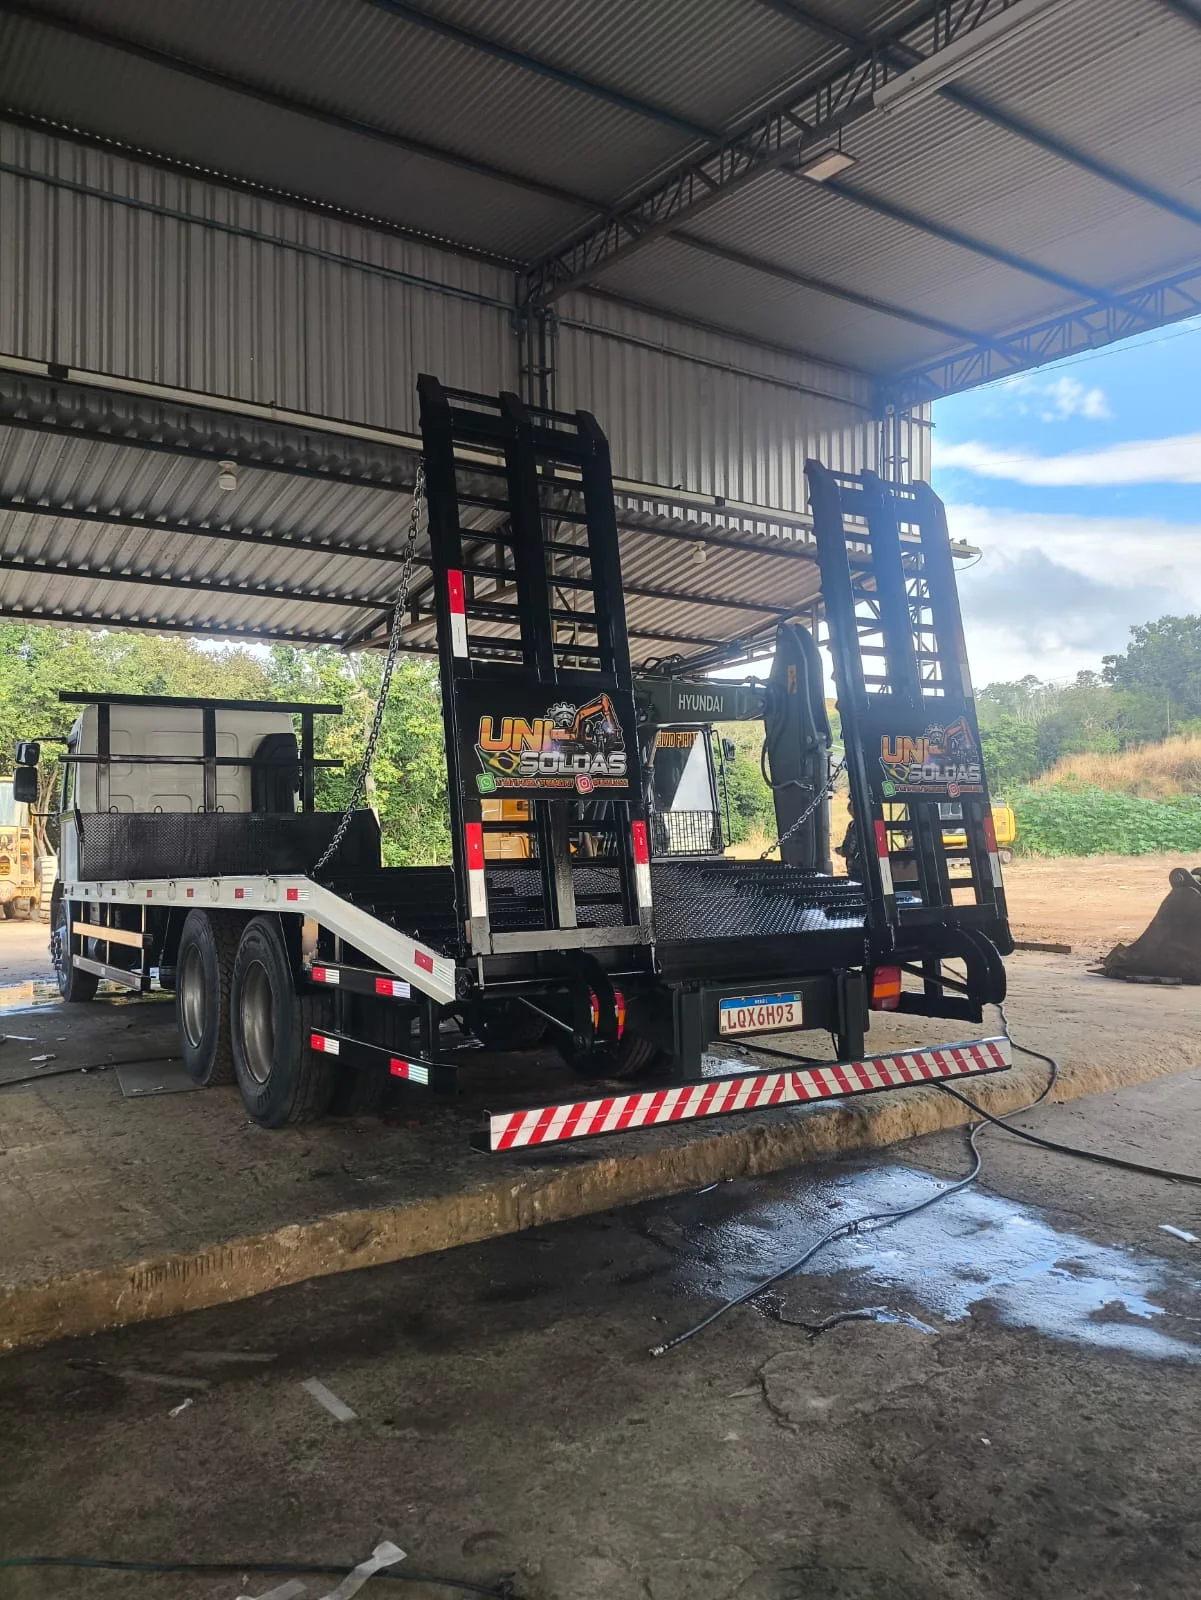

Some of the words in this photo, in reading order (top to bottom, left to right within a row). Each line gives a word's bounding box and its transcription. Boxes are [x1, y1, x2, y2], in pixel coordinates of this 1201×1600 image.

[678, 694, 724, 713] HYUNDAI
[479, 716, 553, 752] UNI
[881, 735, 929, 764] UNI
[520, 752, 627, 776] SOLDAS
[909, 763, 981, 784] SOLDAS
[728, 1004, 794, 1029] LQX6H93
